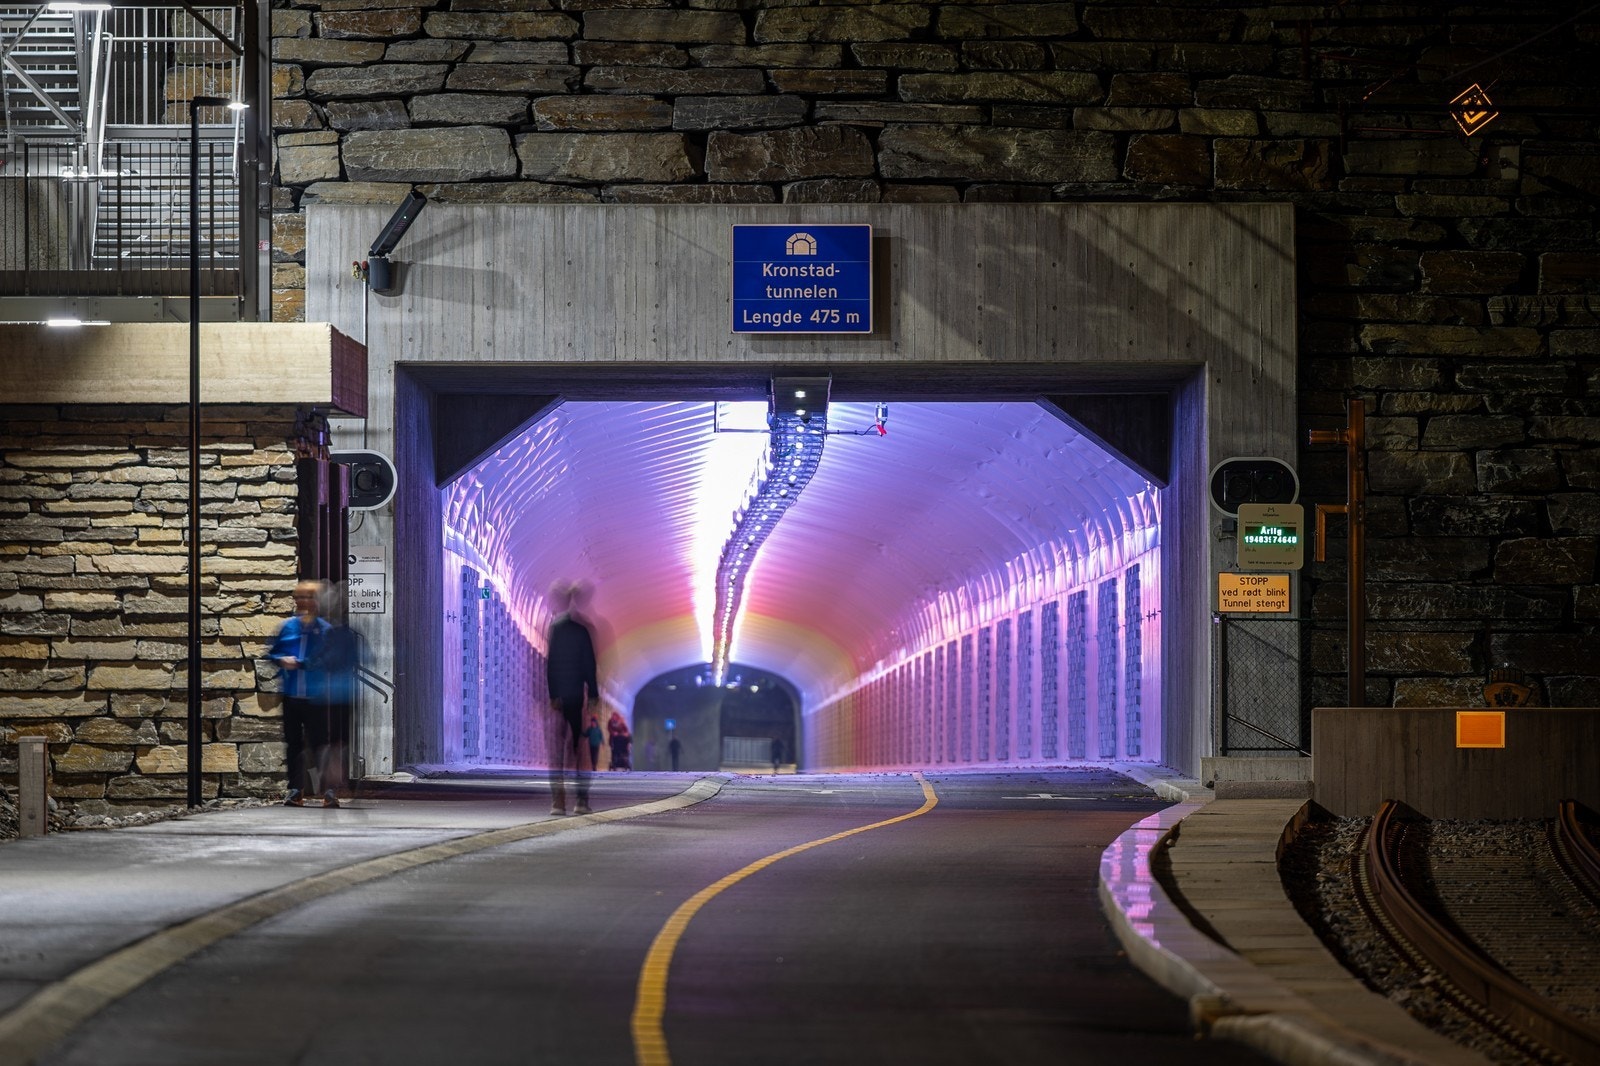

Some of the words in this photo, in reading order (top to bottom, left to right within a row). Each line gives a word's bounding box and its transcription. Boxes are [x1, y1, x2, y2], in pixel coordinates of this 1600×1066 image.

[762, 262, 840, 277] Kronstad-
[766, 284, 838, 298] tunnelen
[744, 310, 802, 327] Lengde
[810, 310, 840, 324] 475
[846, 312, 860, 324] m
[348, 578, 364, 586] OPP
[1240, 577, 1268, 586] STOPP
[362, 589, 382, 597] blink
[1222, 588, 1238, 596] ved
[1242, 588, 1262, 596] rødt
[1266, 588, 1286, 596] blink
[352, 601, 380, 610] stengt
[1223, 599, 1252, 608] Tunnel
[1256, 600, 1286, 610] stengt
